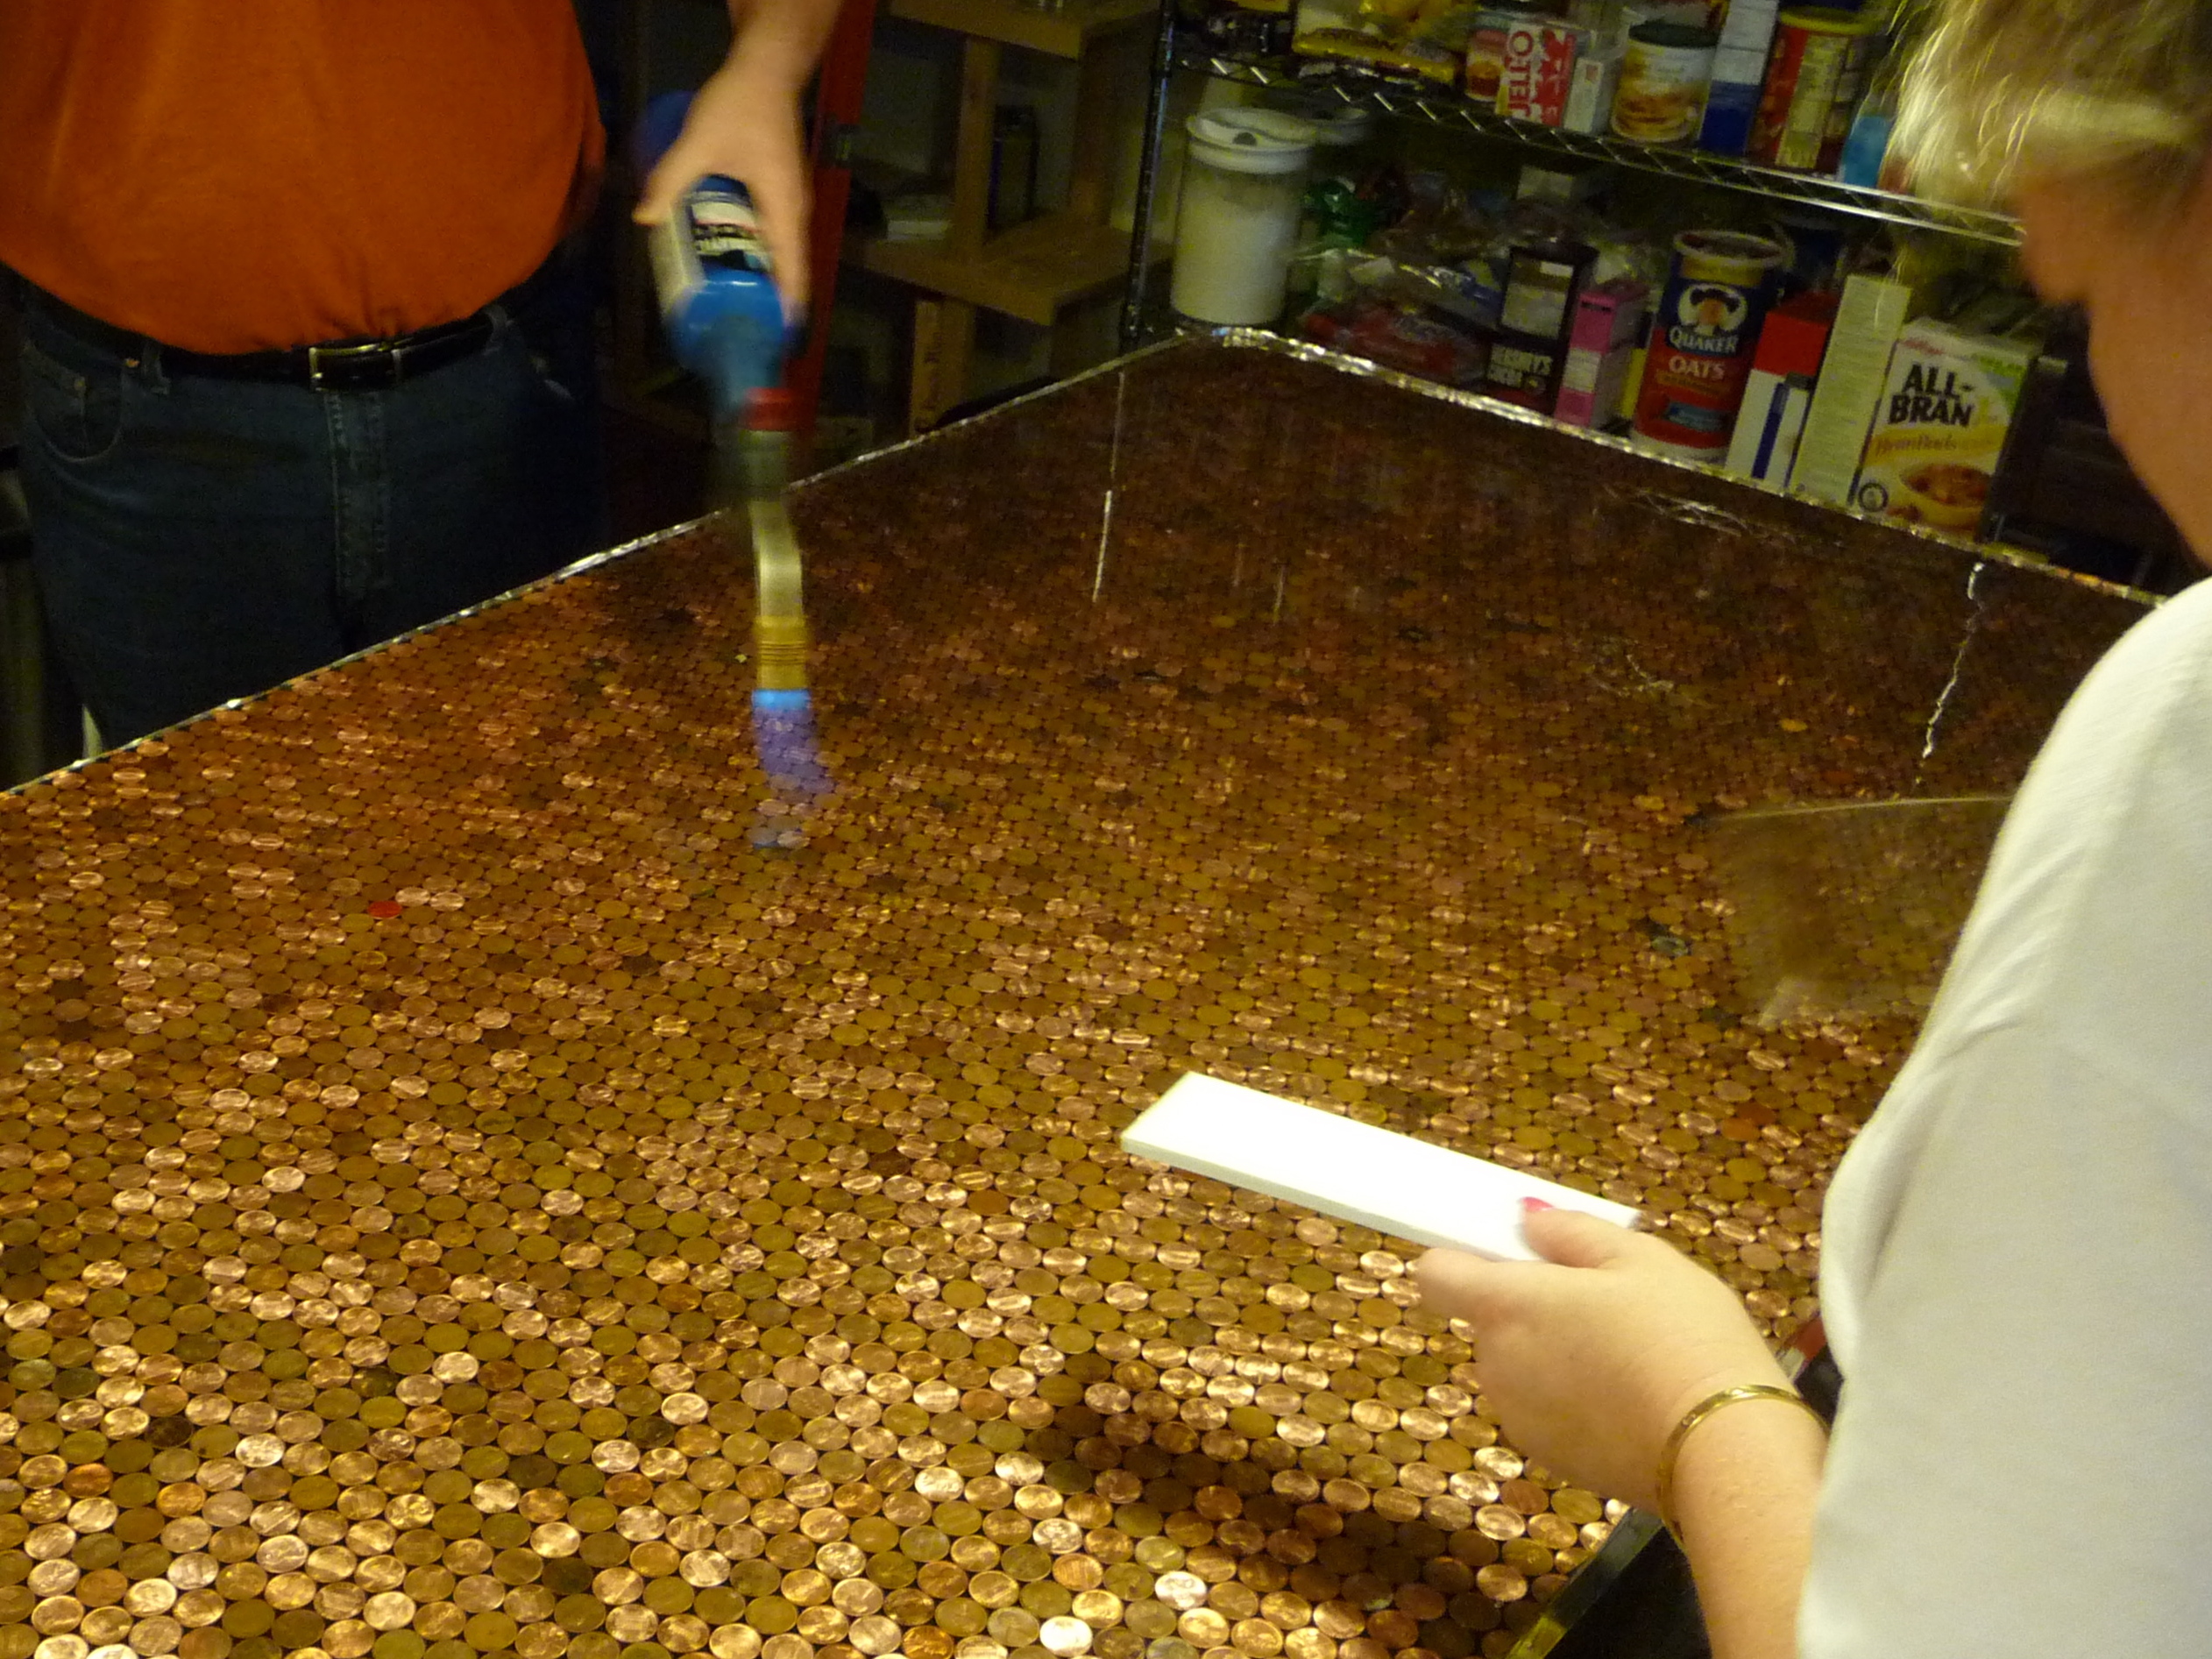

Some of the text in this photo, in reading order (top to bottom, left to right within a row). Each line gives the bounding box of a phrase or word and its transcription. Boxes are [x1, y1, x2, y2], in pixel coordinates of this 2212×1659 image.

[1670, 325, 1739, 353] QUAKER
[1668, 355, 1726, 380] OATS
[1902, 362, 1974, 399] ALL-
[1888, 393, 1975, 428] BRAN
